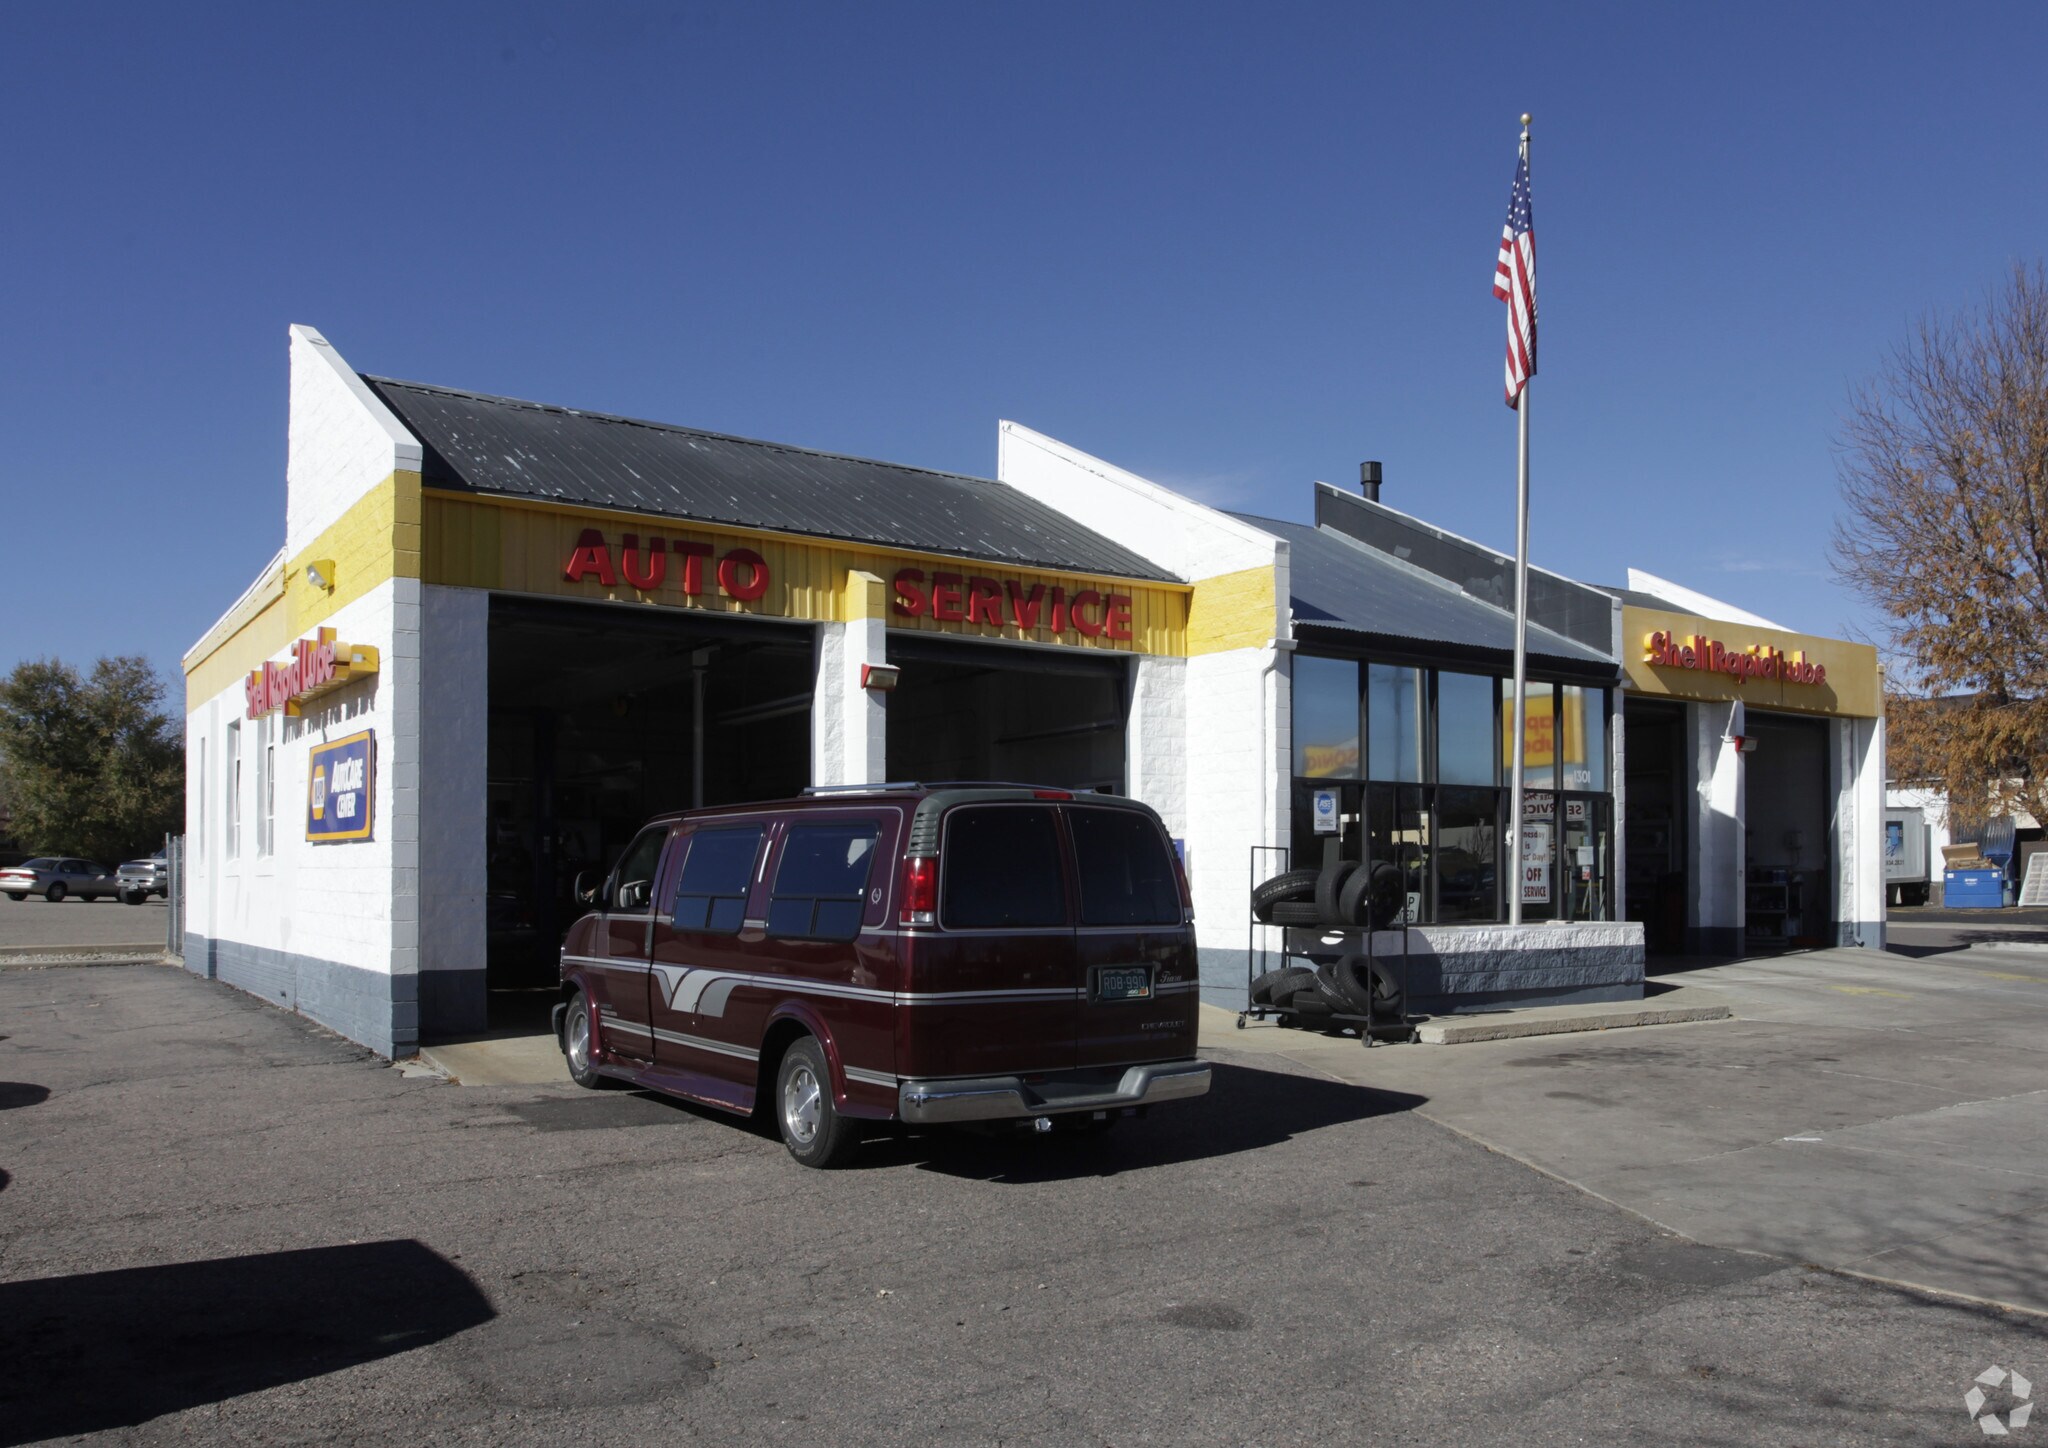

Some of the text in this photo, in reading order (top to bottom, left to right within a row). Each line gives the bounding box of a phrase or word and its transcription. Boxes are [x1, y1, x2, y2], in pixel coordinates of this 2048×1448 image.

[564, 528, 1134, 641] AUTO SERVICE
[1651, 630, 1826, 685] Shell Rapid Lube
[245, 660, 270, 720] Shell
[302, 627, 336, 692] Lube
[1573, 769, 1591, 783] 1301
[1526, 867, 1542, 881] OFF
[1523, 885, 1546, 897] SERVICE
[1141, 1020, 1184, 1030] CHEVROLET
